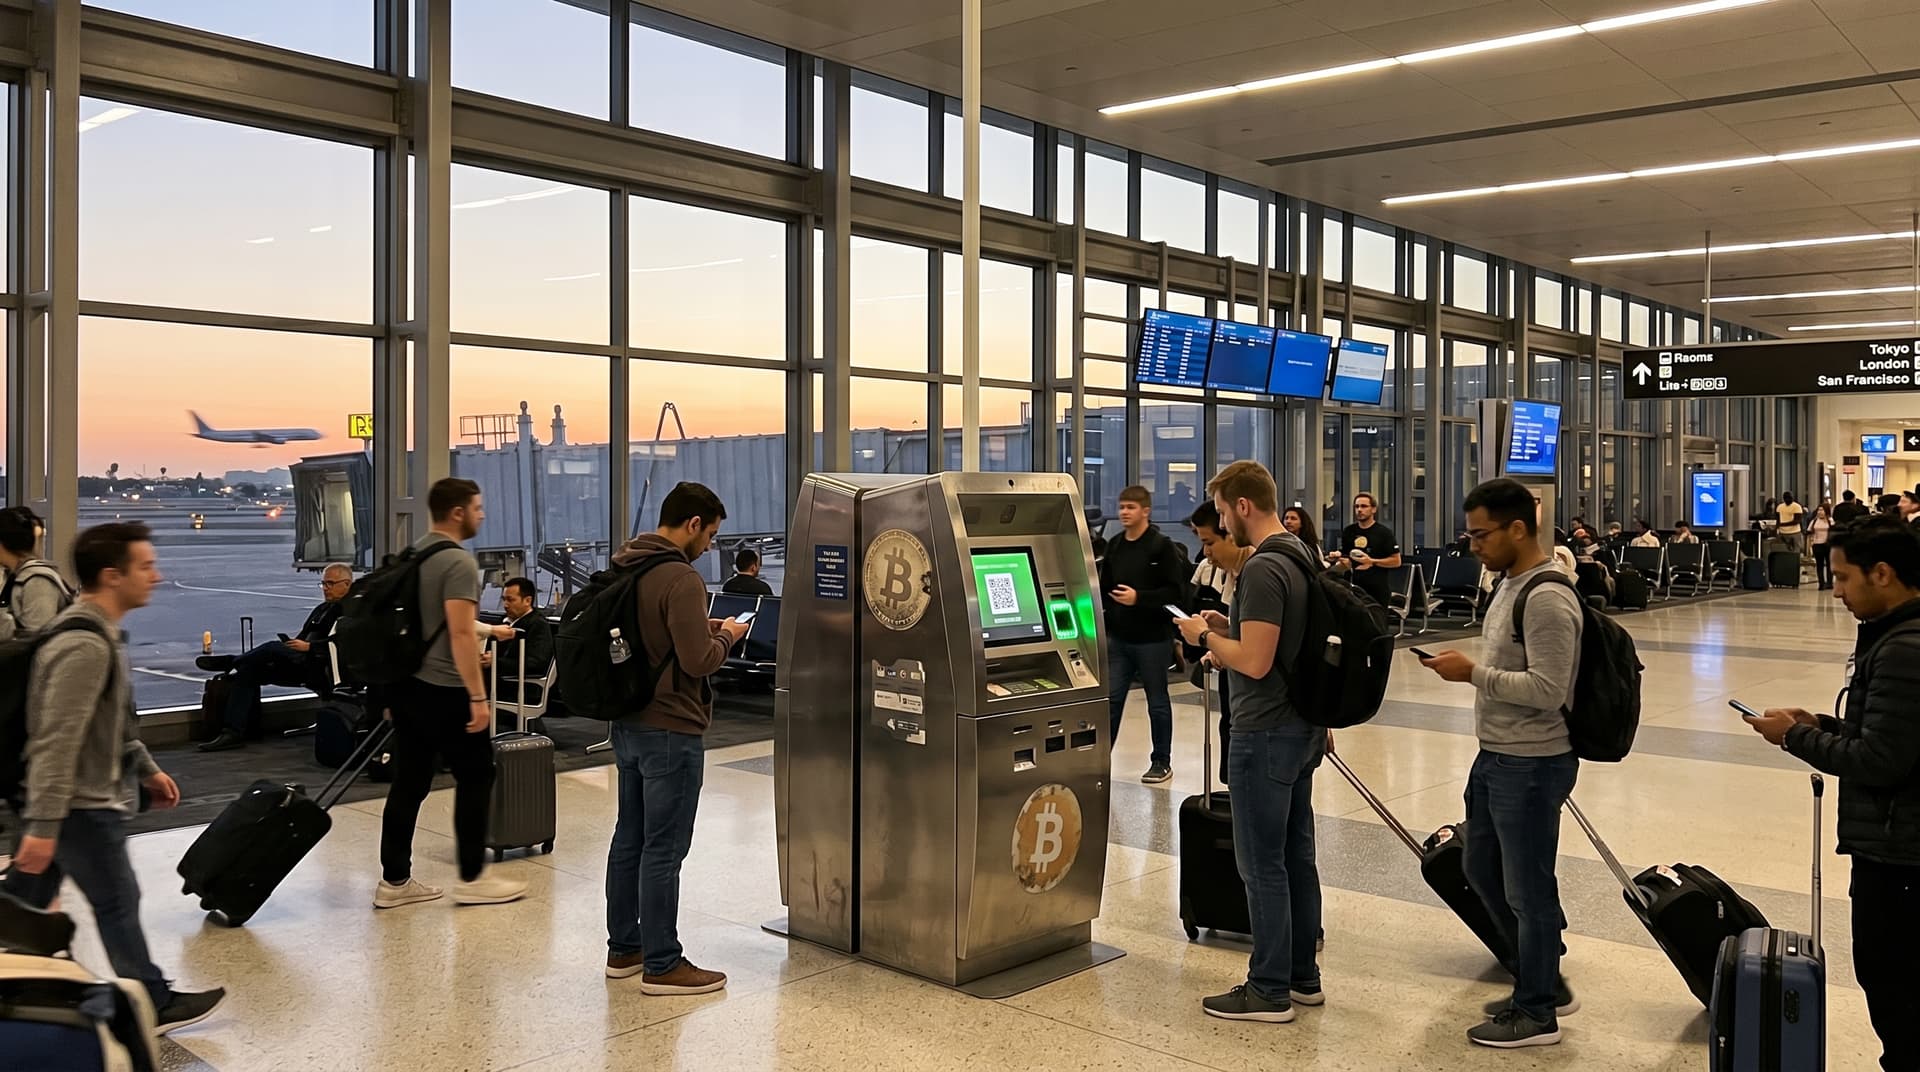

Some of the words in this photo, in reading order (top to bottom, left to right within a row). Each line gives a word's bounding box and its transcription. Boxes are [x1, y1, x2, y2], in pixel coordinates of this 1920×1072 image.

[1869, 343, 1910, 357] Tokyo
[1860, 358, 1910, 371] London
[1817, 374, 1843, 386] San
[1845, 373, 1910, 385] Francisco
